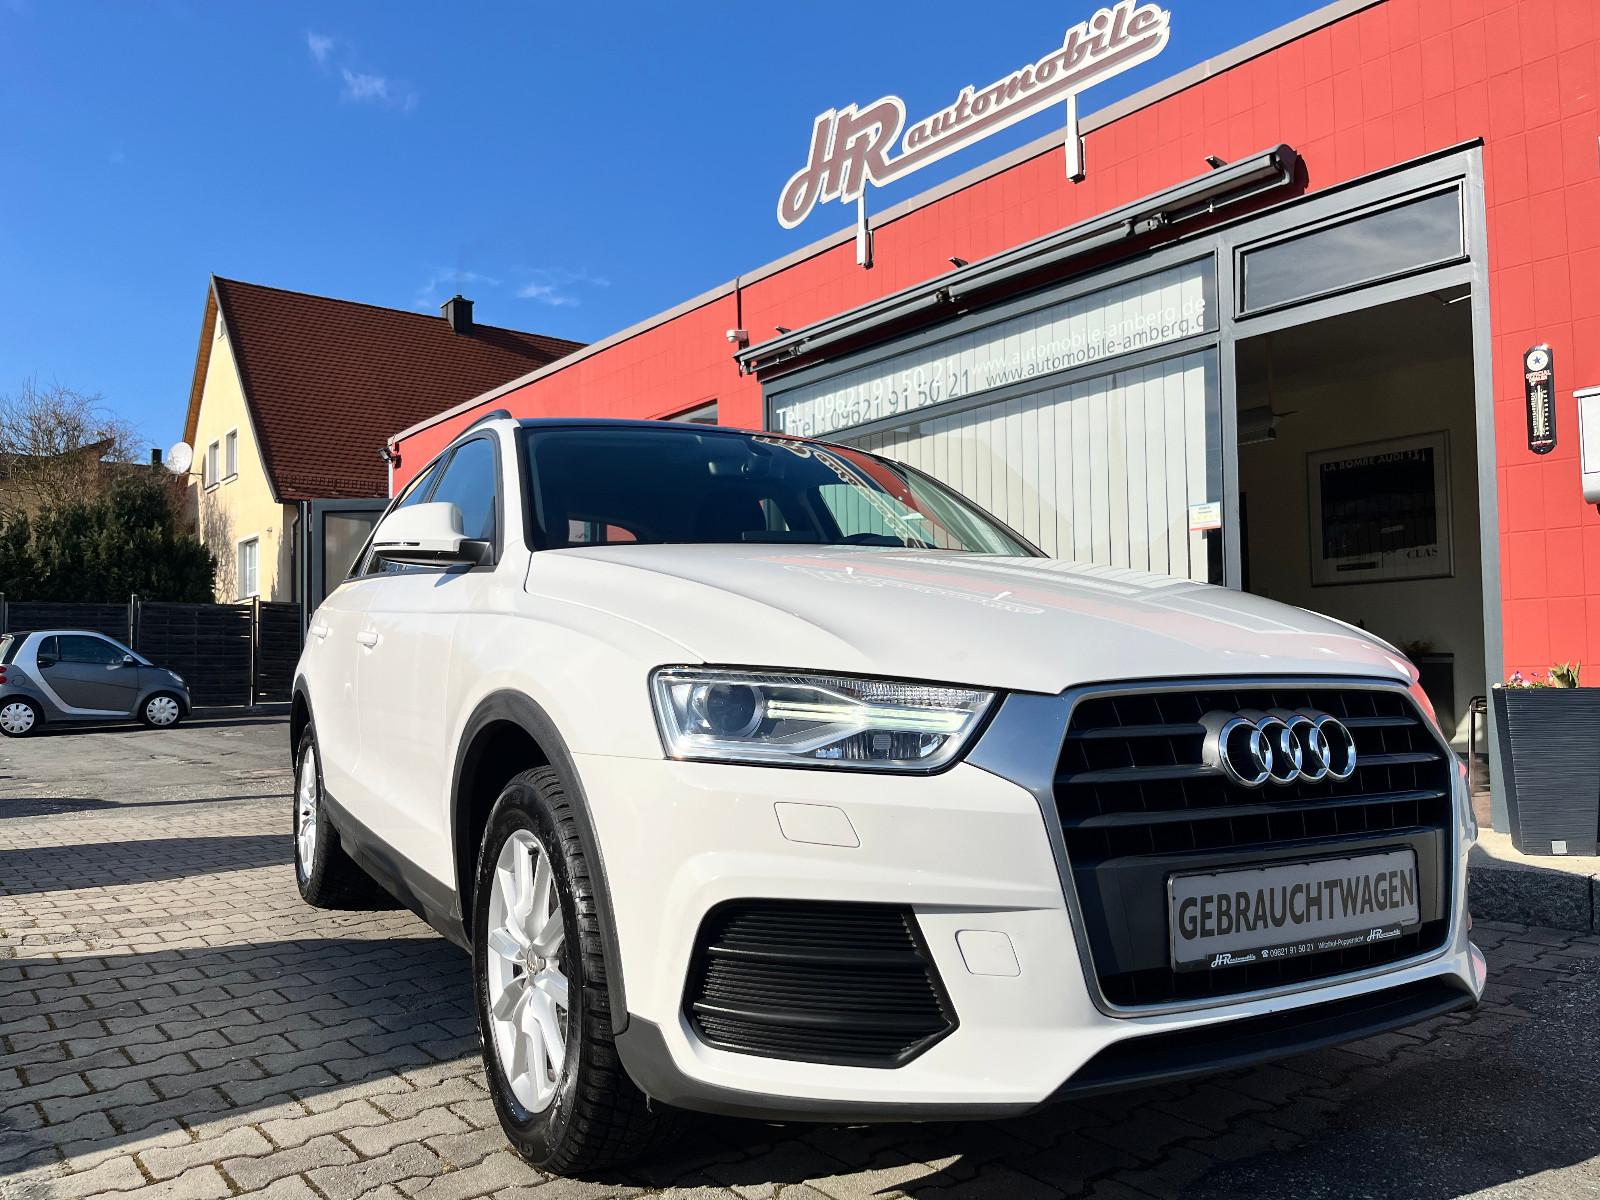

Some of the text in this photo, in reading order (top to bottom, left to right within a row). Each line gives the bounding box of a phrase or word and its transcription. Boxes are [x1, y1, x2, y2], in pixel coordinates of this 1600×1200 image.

[780, 1, 1168, 225] HR automobile
[814, 384, 865, 418] 09621
[873, 376, 893, 403] 91
[902, 367, 926, 396] 50
[933, 358, 955, 386] 21
[970, 298, 1206, 374] www.automobile-amberg.de
[1323, 463, 1337, 473] LA
[1377, 451, 1404, 464] AUDI
[1178, 868, 1414, 940] GEBRAUCHTWAGEN
[1289, 946, 1297, 954] 91
